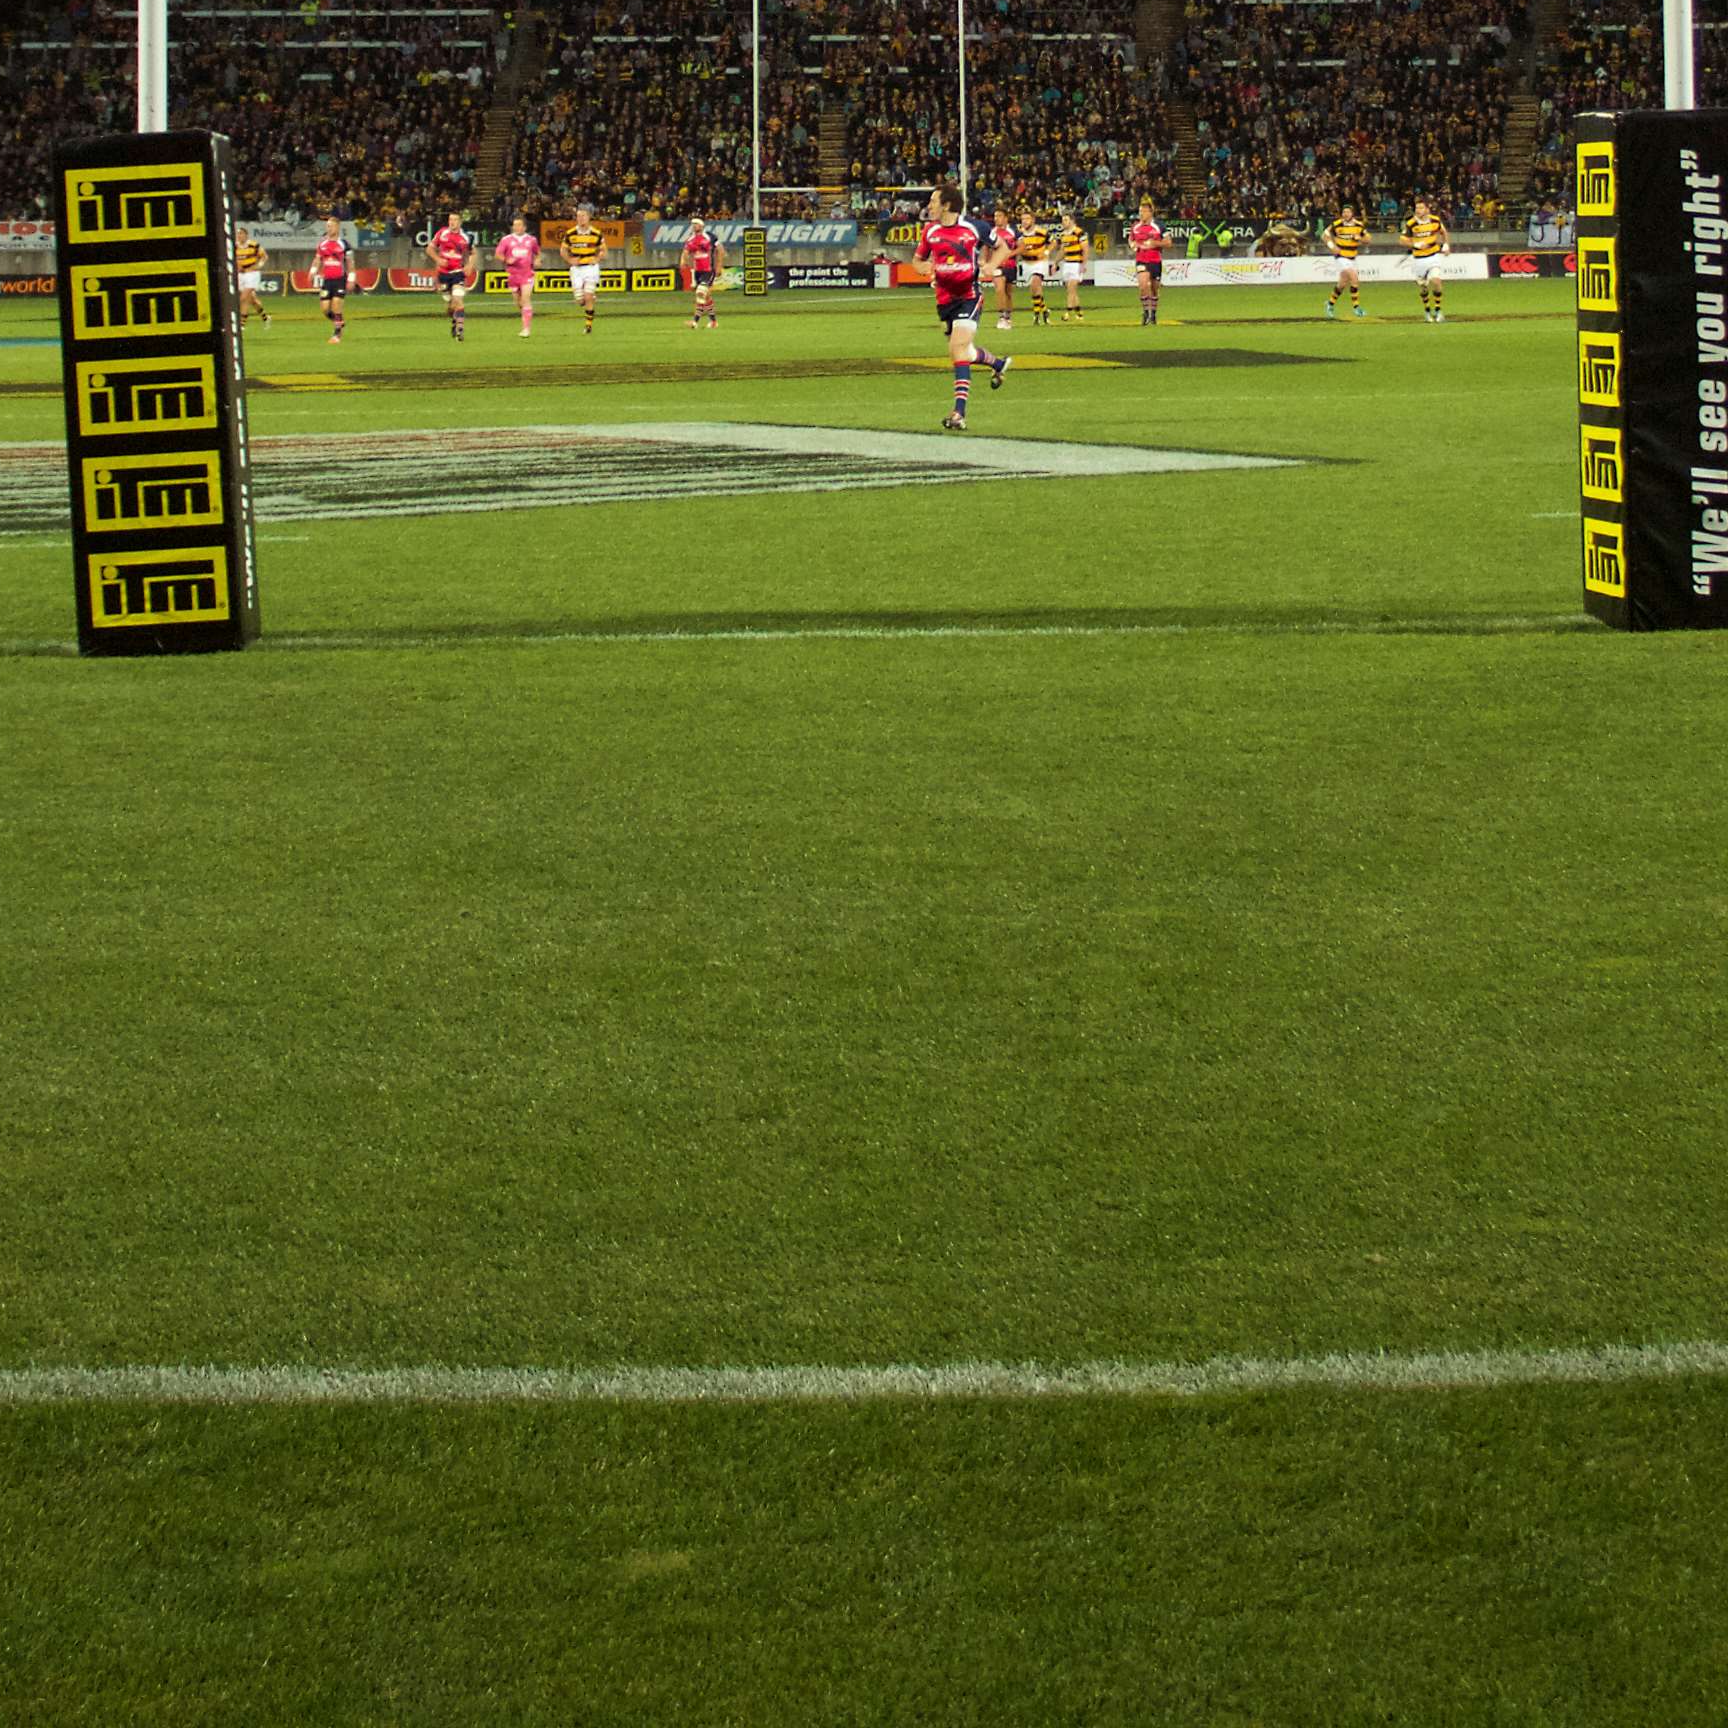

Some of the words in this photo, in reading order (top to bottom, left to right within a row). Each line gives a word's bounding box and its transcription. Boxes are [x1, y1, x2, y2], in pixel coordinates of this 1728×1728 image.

[653, 223, 852, 243] MANFEIGHT
[633, 240, 642, 255] 3
[1096, 240, 1105, 252] 4
[788, 267, 805, 276] the
[806, 267, 832, 279] paint
[834, 267, 848, 276] the
[788, 277, 849, 289] professionals
[852, 278, 868, 287] use
[1698, 379, 1728, 453] see
